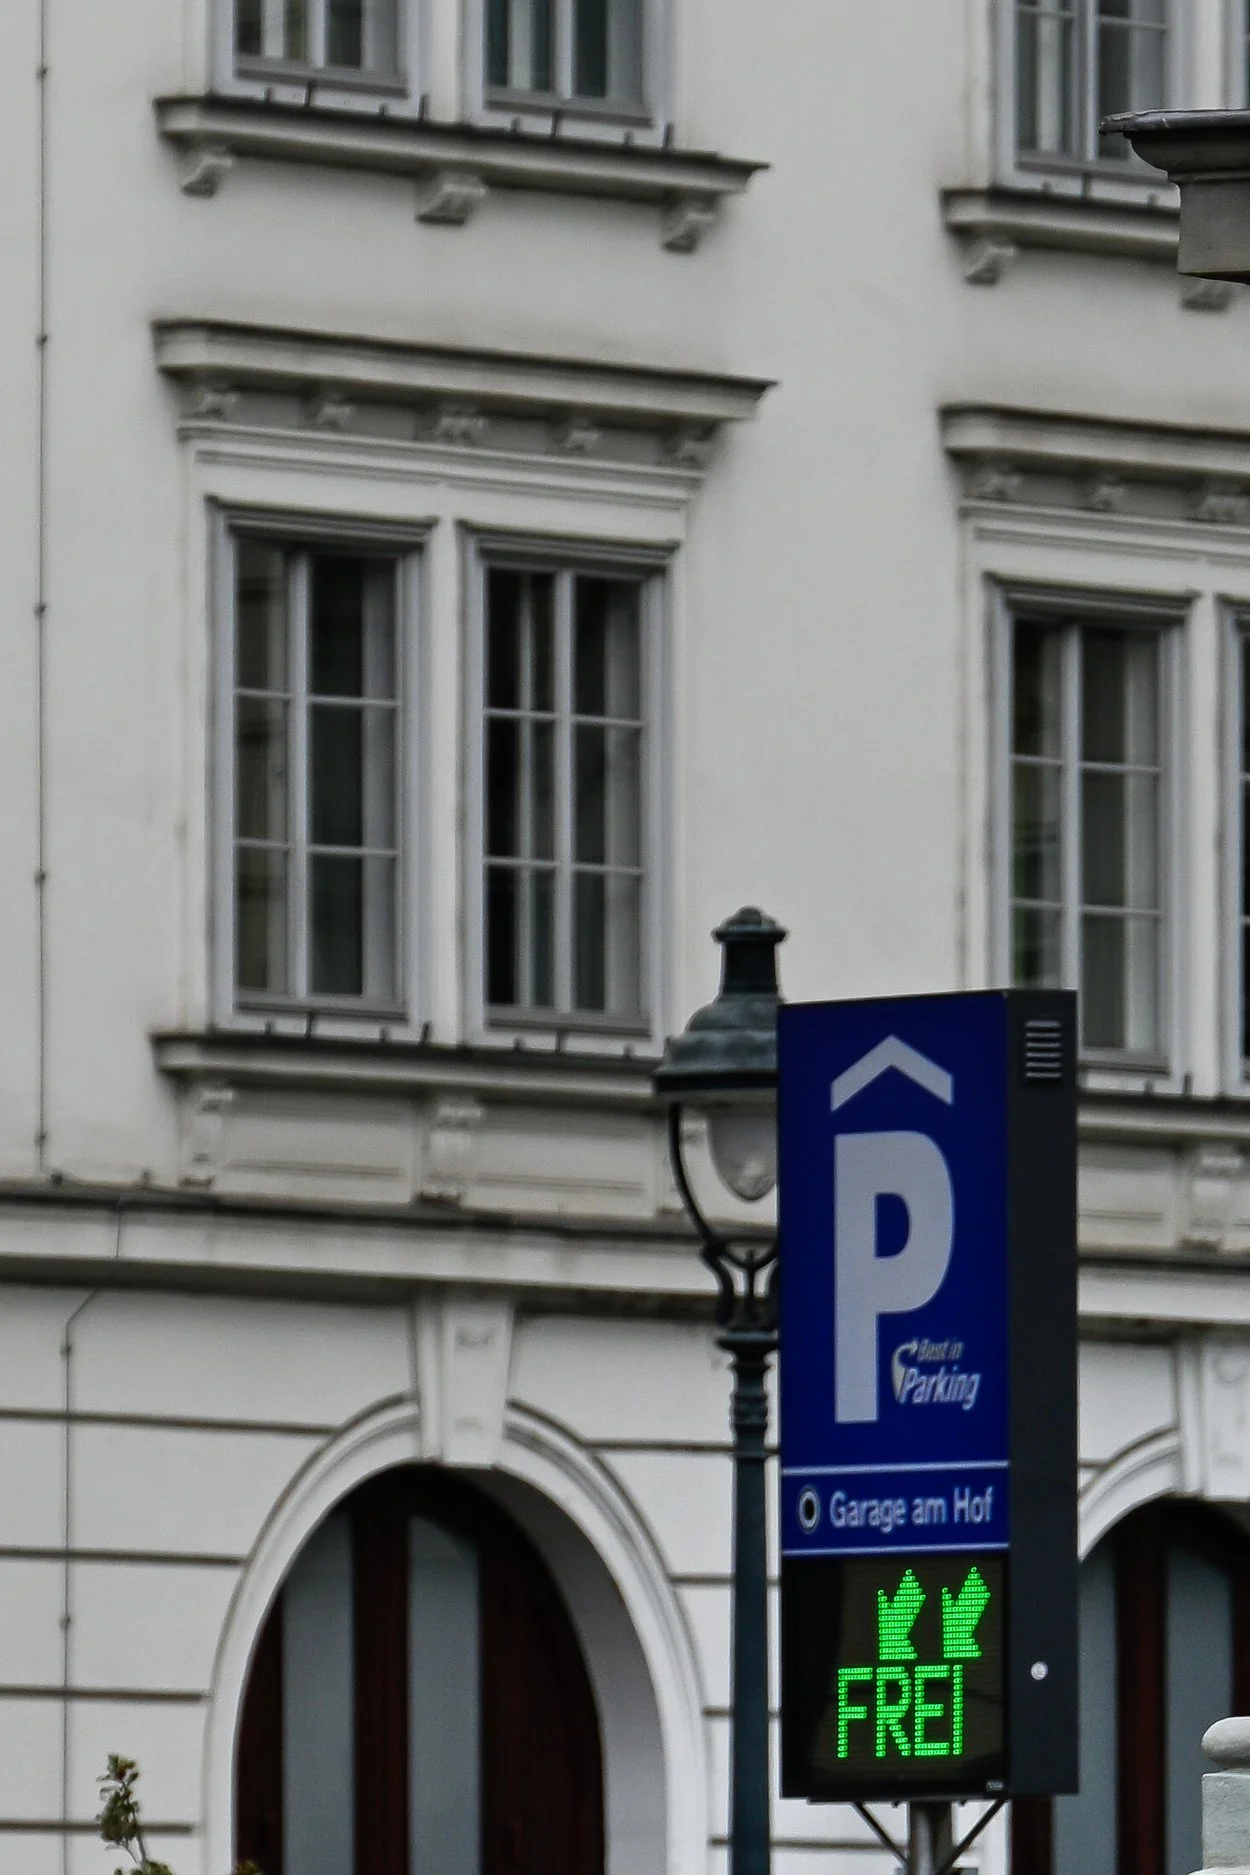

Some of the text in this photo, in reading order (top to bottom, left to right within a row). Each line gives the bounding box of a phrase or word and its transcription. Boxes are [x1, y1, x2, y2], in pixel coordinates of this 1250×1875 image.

[834, 1130, 955, 1424] P
[899, 1365, 981, 1411] Parking
[830, 1485, 994, 1534] Garage am Hof
[836, 1664, 964, 1759] FREI
